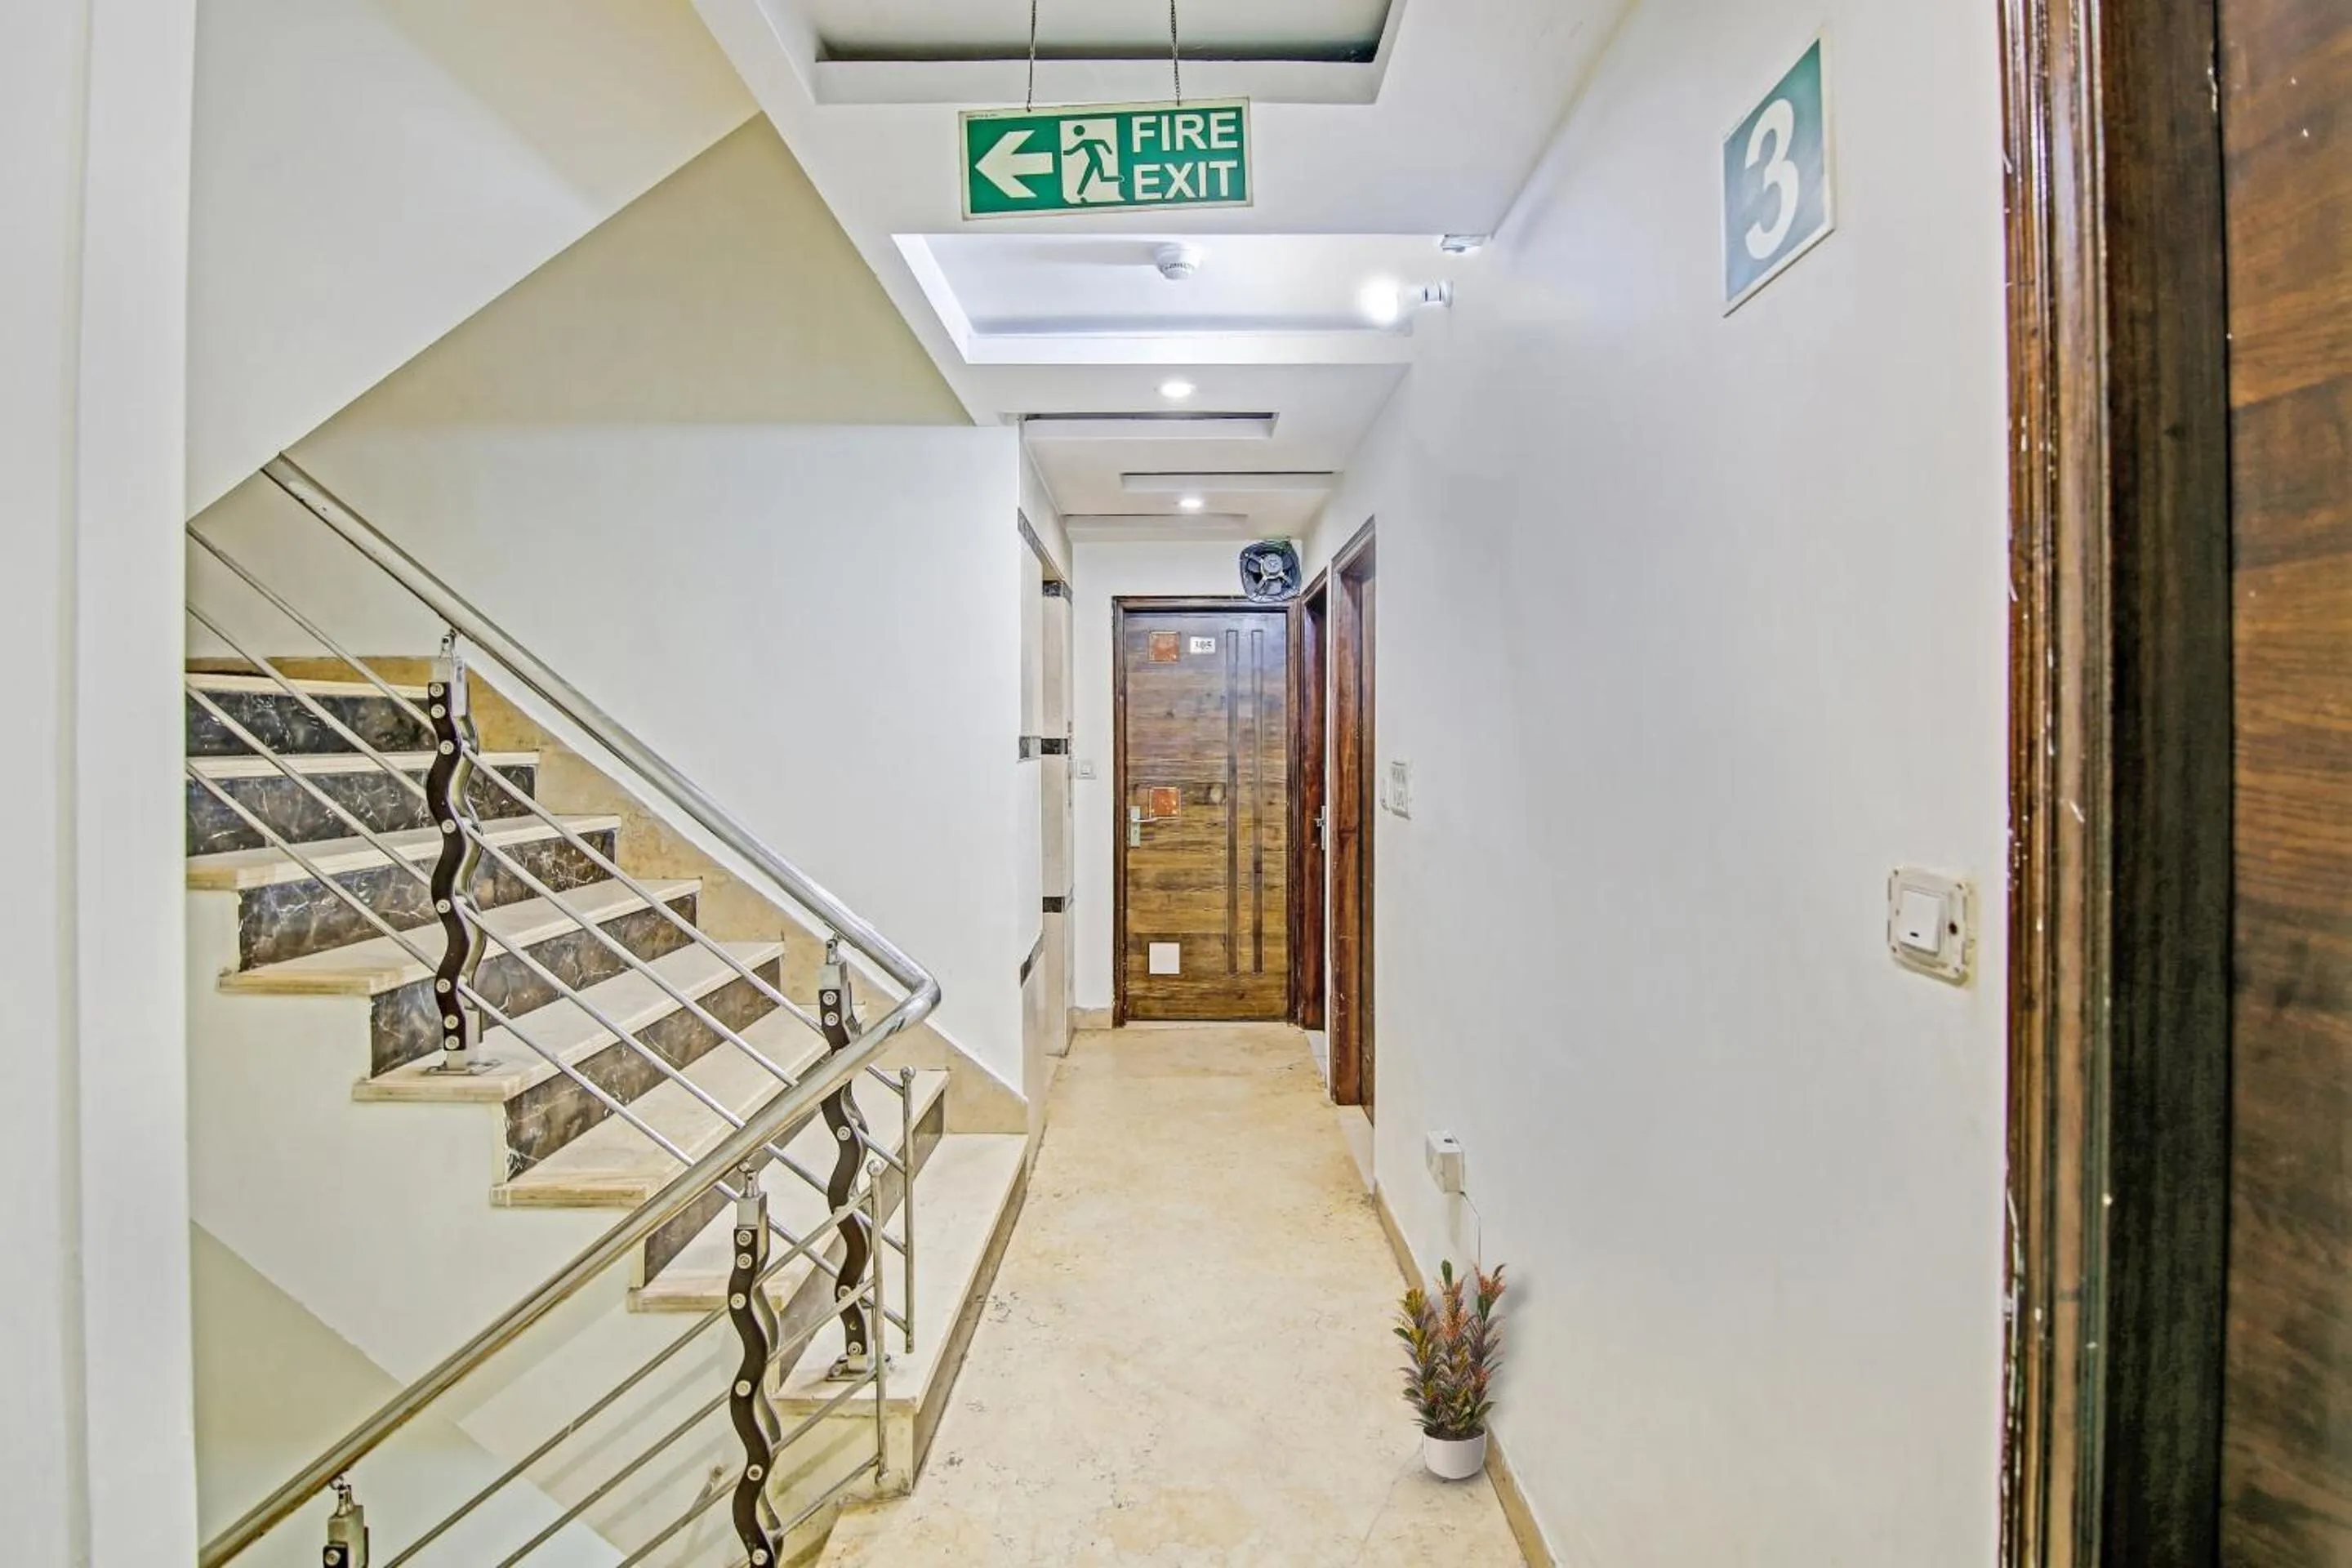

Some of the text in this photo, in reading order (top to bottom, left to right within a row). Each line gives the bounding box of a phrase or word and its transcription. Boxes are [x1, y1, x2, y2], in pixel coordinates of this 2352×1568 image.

[1131, 111, 1238, 153] FIRE
[1133, 161, 1238, 201] EXIT
[1744, 98, 1799, 260] 3
